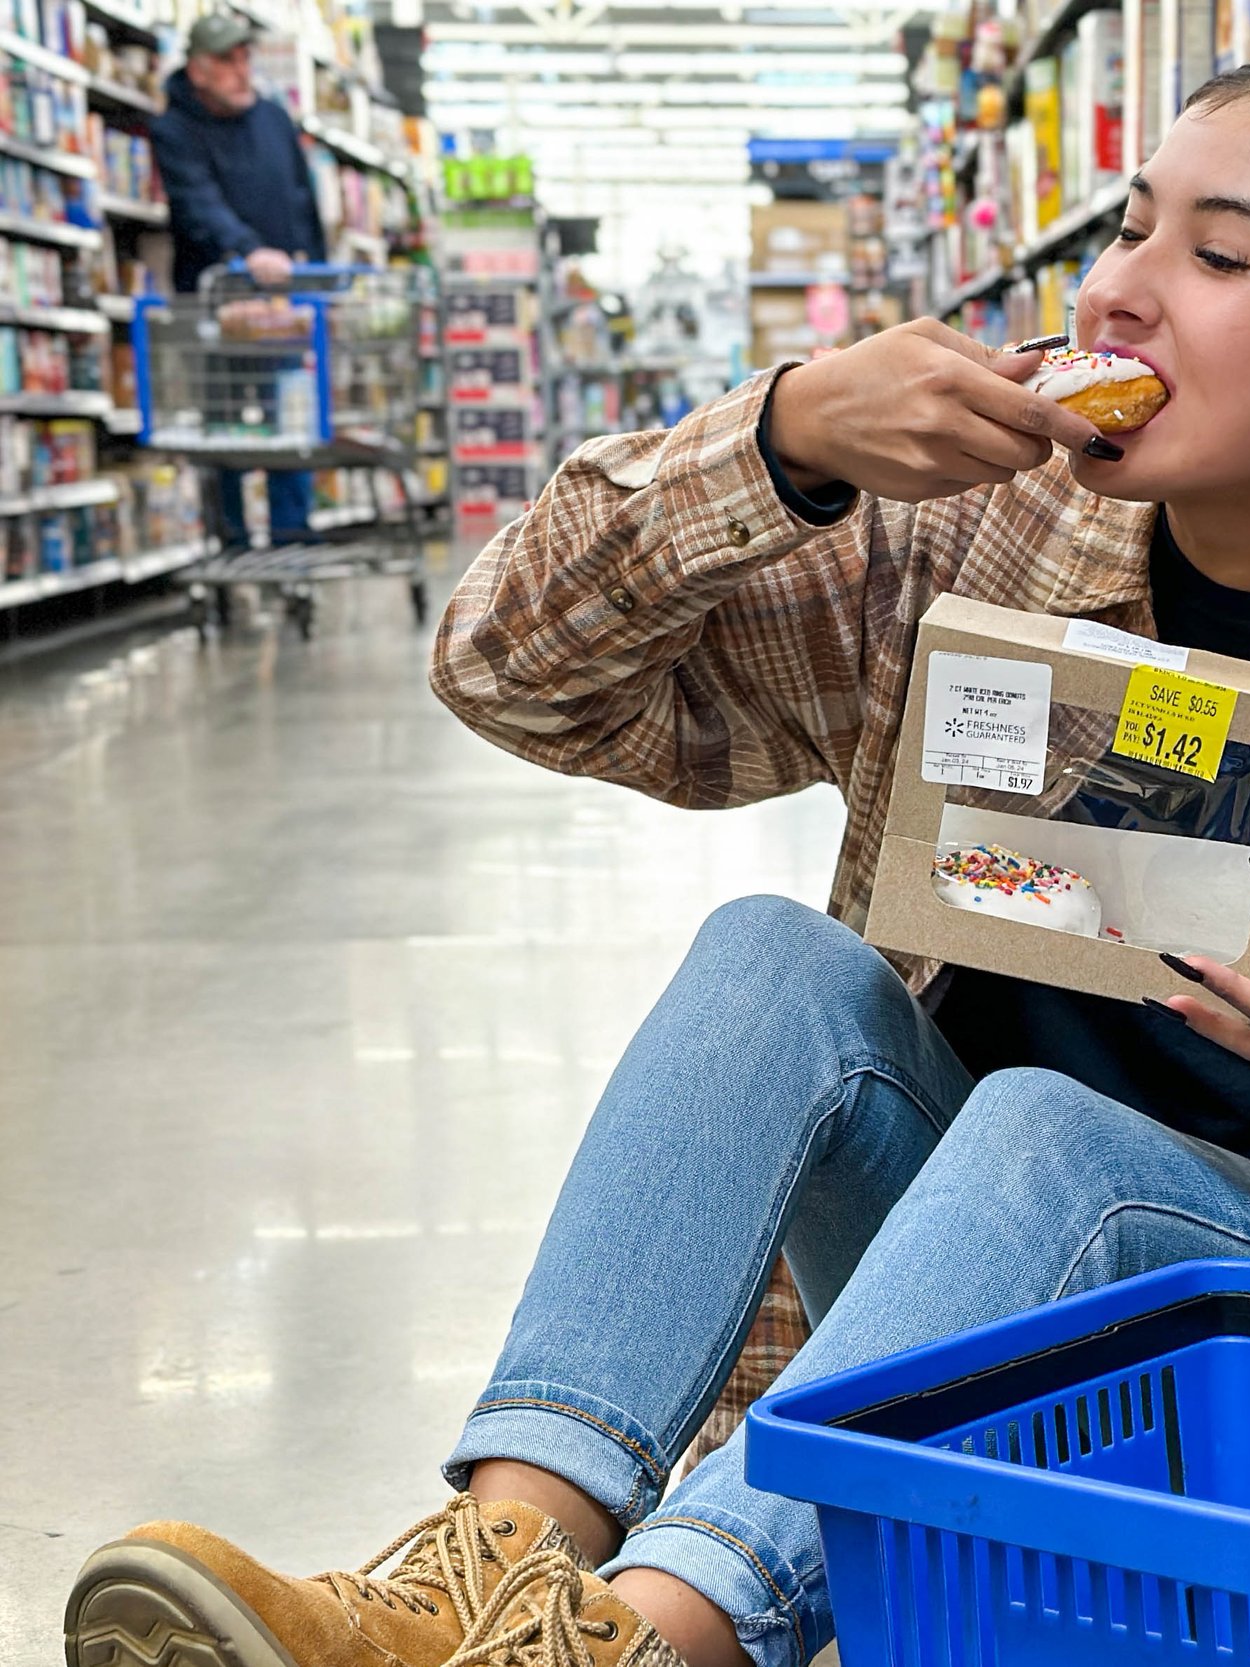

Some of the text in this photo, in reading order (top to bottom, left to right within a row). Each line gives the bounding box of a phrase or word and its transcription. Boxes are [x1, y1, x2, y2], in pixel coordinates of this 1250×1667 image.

[1005, 691, 1026, 700] DONUTS
[1150, 684, 1219, 717] SAVE $0.55
[962, 707, 973, 715] NET
[975, 708, 983, 716] WT
[966, 720, 1026, 735] FRESHNESS
[966, 730, 1026, 744] GUARANTEED
[1142, 721, 1202, 767] $1.42
[1008, 776, 1033, 790] $1.97
